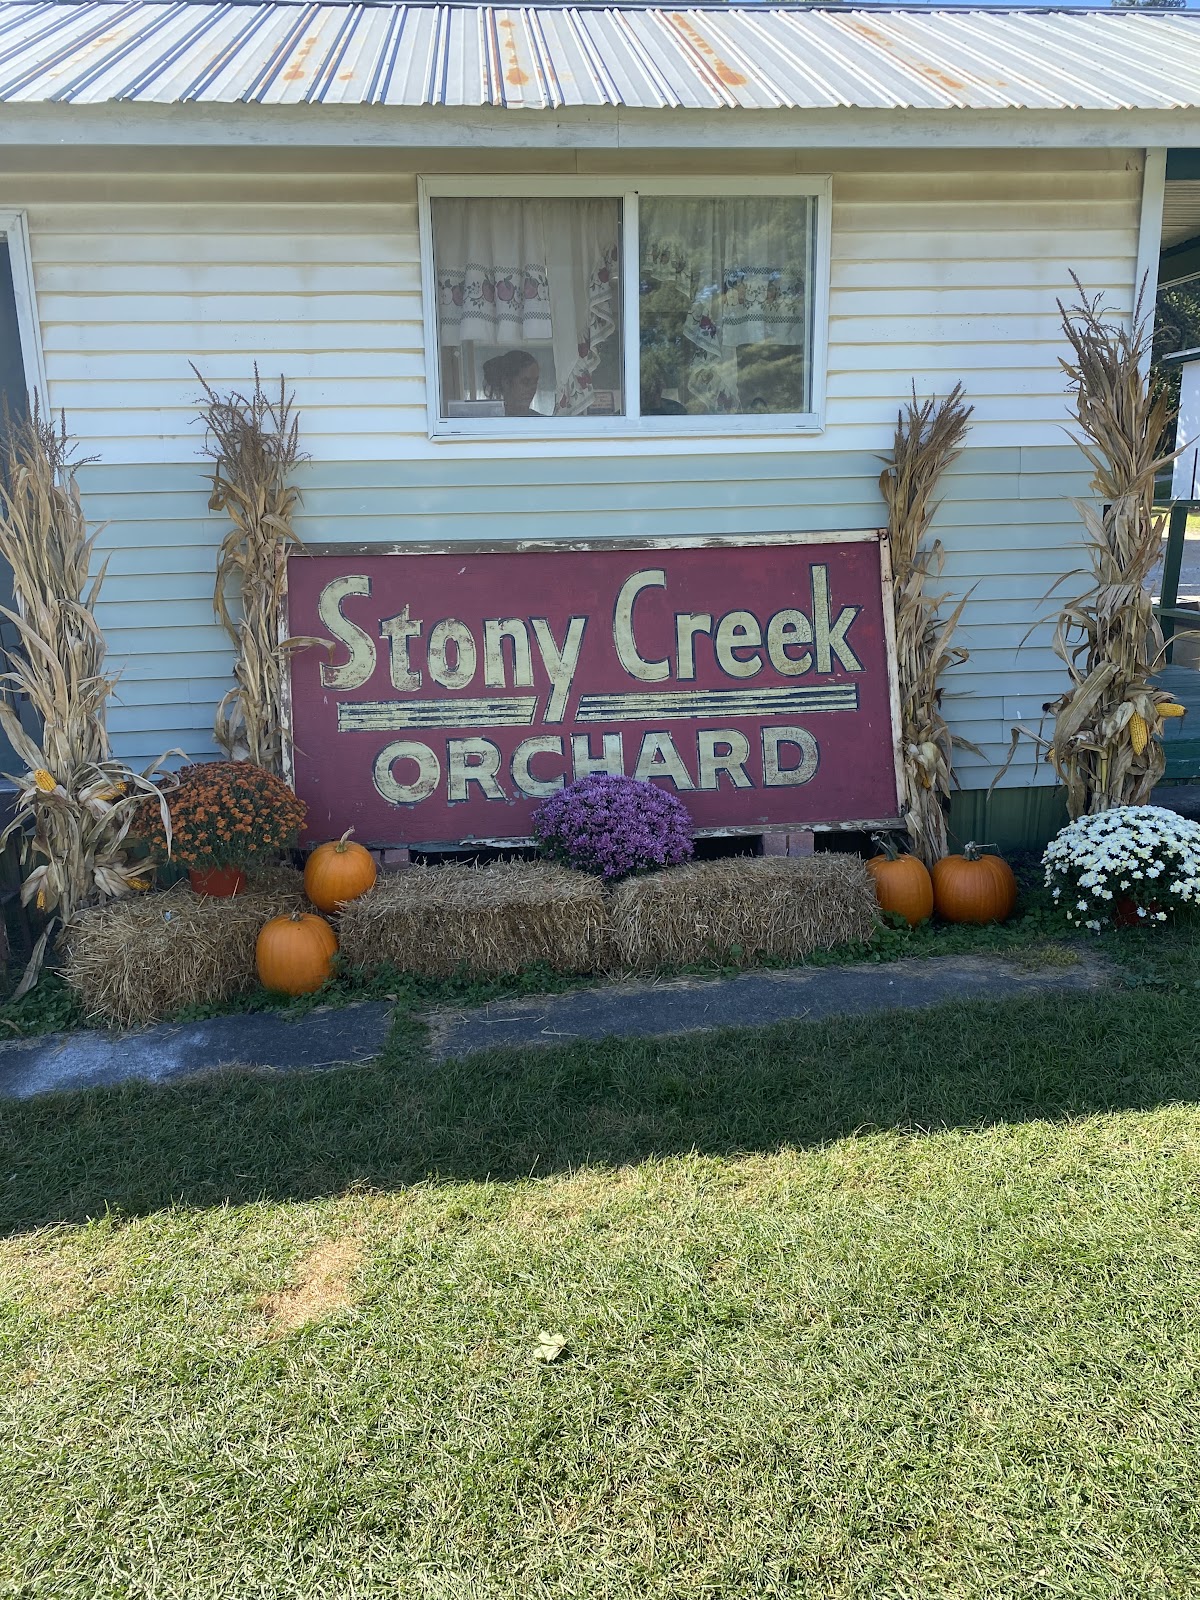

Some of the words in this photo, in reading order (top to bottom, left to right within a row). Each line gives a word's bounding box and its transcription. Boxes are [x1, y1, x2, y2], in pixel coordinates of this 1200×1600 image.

[318, 574, 589, 725] Stony
[613, 563, 866, 682] Creek
[373, 726, 820, 804] ORCHARD
